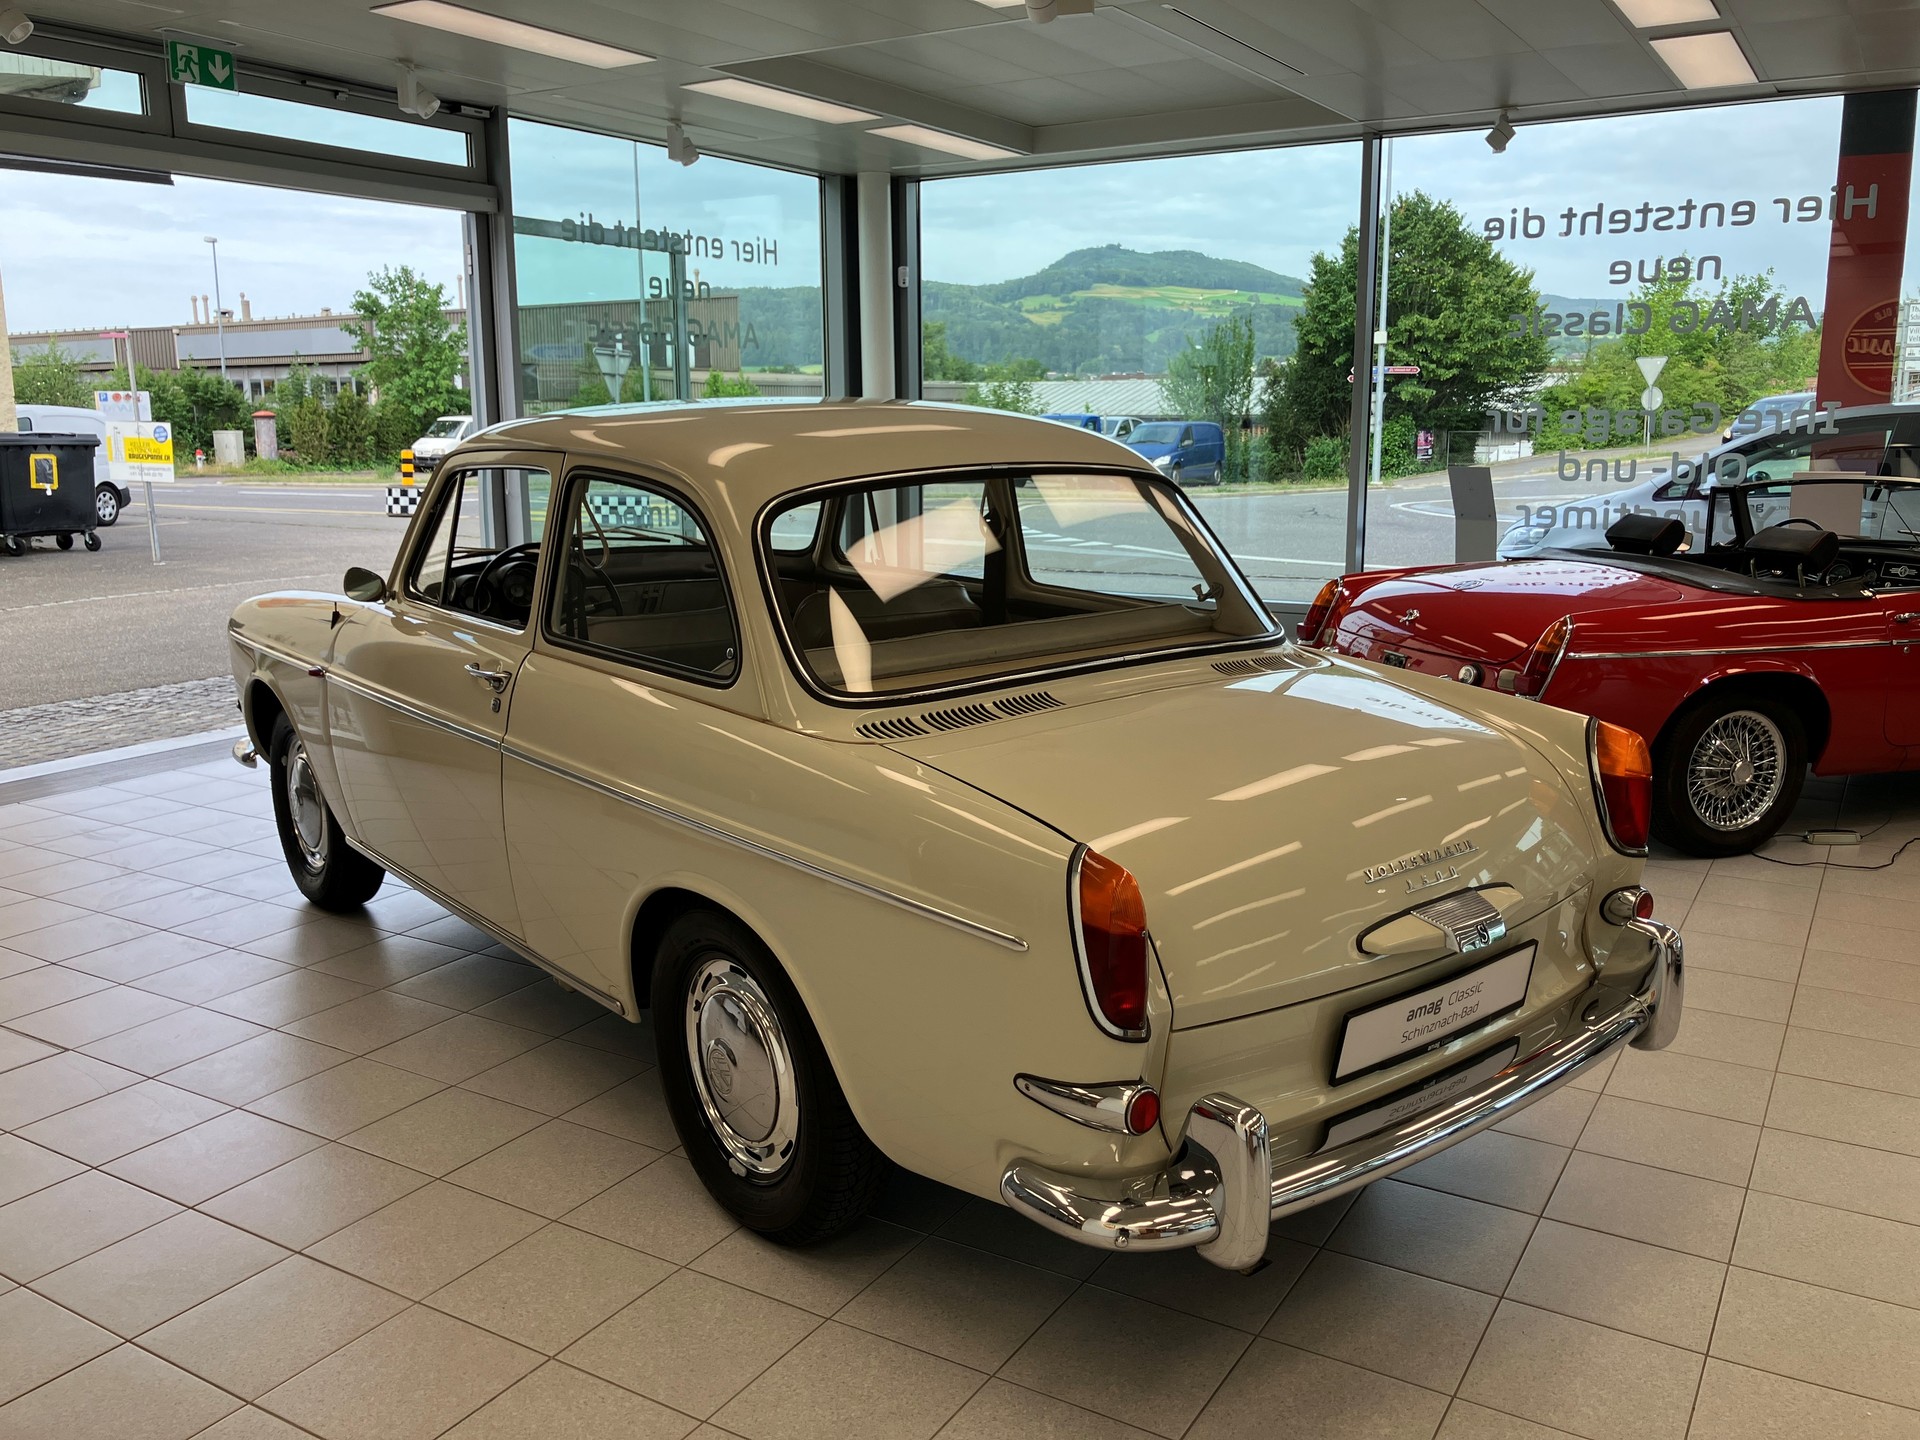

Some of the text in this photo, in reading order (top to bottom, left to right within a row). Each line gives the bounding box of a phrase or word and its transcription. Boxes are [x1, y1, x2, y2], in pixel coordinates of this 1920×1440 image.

[1363, 839, 1477, 883] VOLKSWAGEN
[1405, 865, 1459, 892] 1500
[1401, 1001, 1480, 1044] Schinznach-Bad
[1406, 981, 1484, 1022] amag Classic
